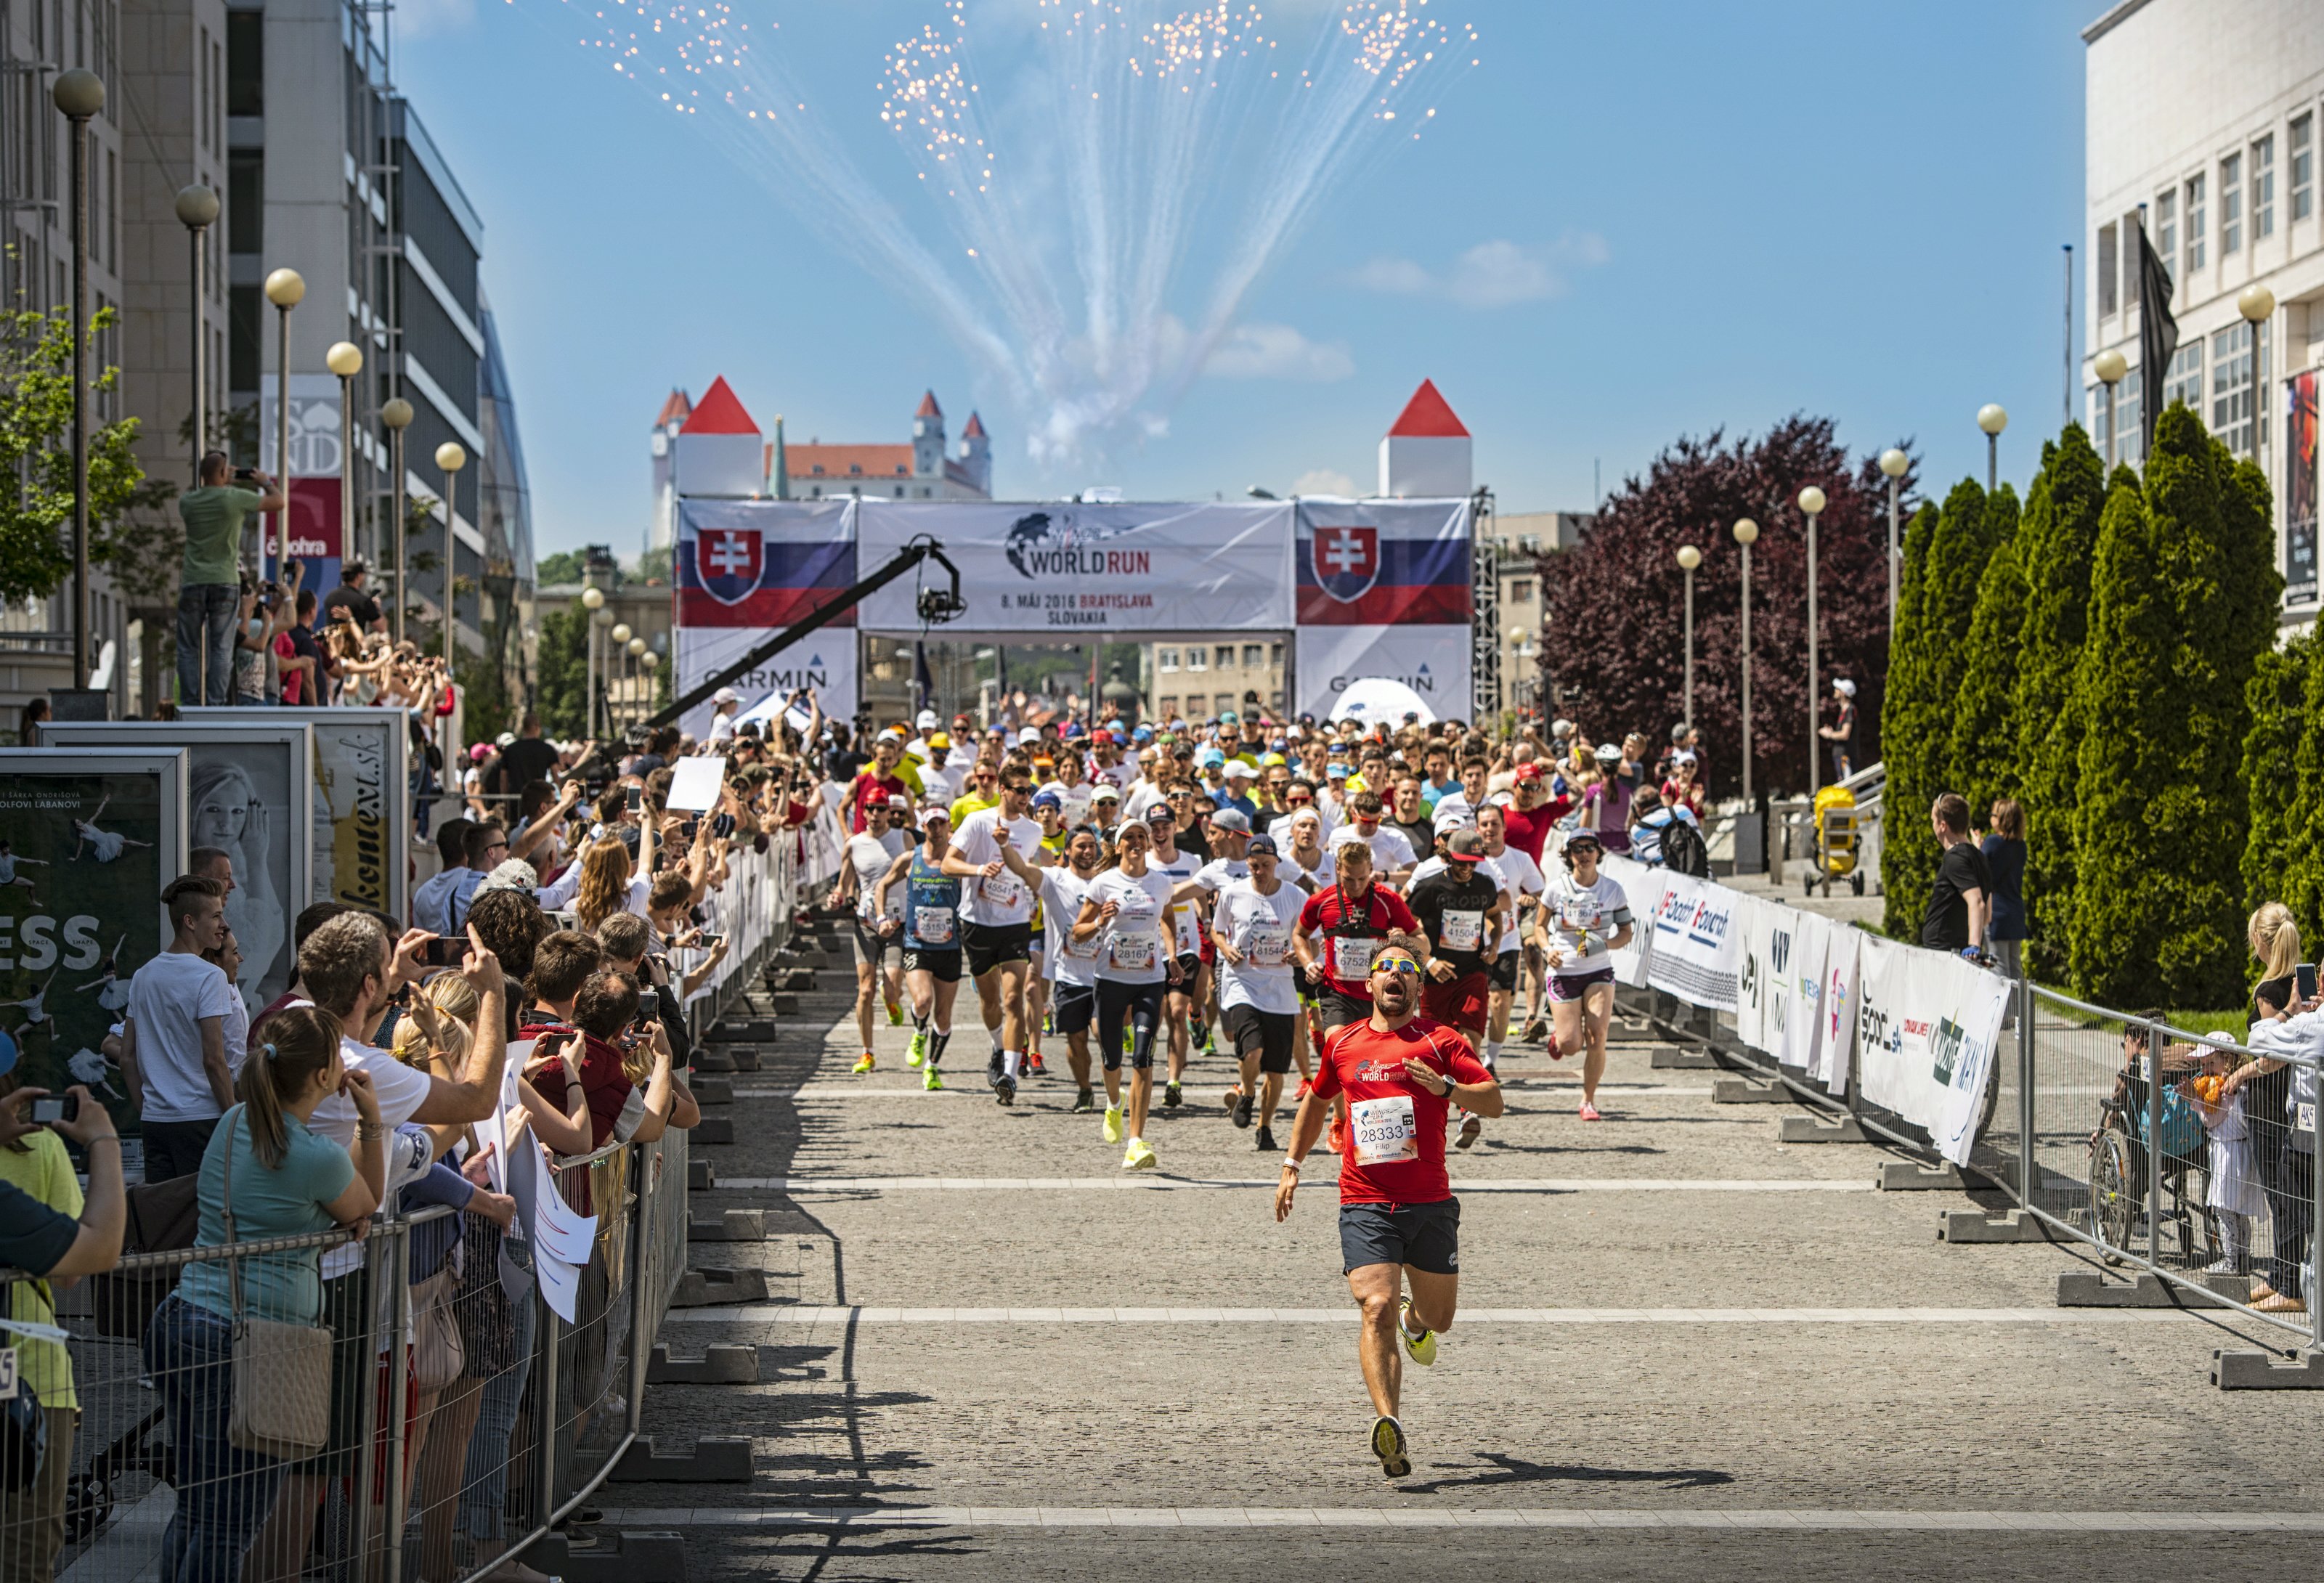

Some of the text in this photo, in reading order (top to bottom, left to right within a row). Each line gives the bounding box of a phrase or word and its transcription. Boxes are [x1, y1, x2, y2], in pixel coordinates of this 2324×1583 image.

[266, 534, 327, 556] čohra
[1044, 594, 1076, 609] 2016
[1079, 593, 1153, 609] BRATISLAVA
[1047, 611, 1107, 625] SLOVAKIA
[1329, 675, 1433, 693] GIN
[1447, 929, 1474, 937] 41504
[1118, 950, 1147, 959] 28167
[1256, 946, 1284, 955] 81544
[1360, 1126, 1404, 1143] 28333
